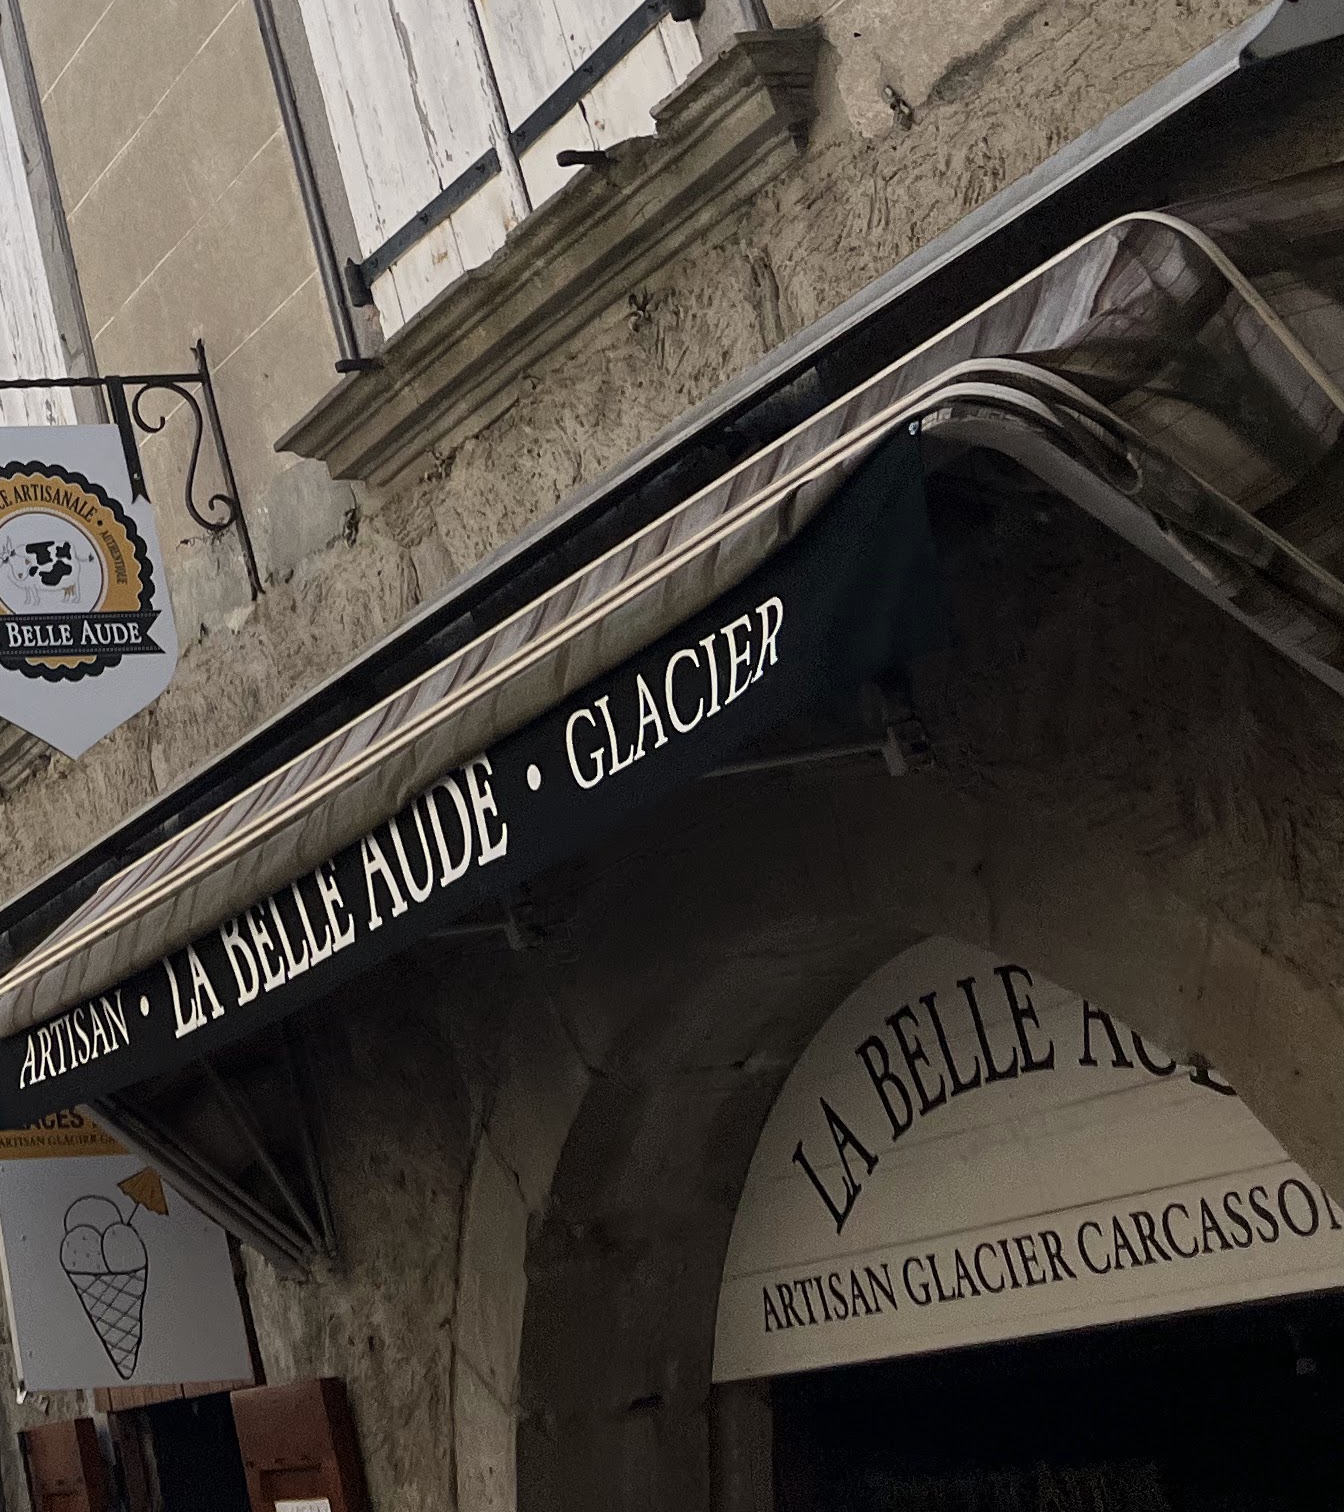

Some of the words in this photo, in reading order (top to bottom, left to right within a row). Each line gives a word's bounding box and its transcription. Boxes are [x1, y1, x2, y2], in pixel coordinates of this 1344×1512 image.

[13, 483, 98, 524] ARTISANALE
[6, 621, 74, 648] BELLE
[80, 619, 143, 646] AUDE
[19, 988, 130, 1089] ARTISAN
[163, 943, 225, 1039] LA
[219, 859, 355, 1007] BELLE
[361, 752, 508, 932] AUDE
[566, 596, 784, 789] GLACIER
[792, 1096, 879, 1235] LA
[855, 964, 1055, 1141] BELLE
[762, 1263, 899, 1333] ARTISAN
[903, 1230, 1078, 1307] GLACIER
